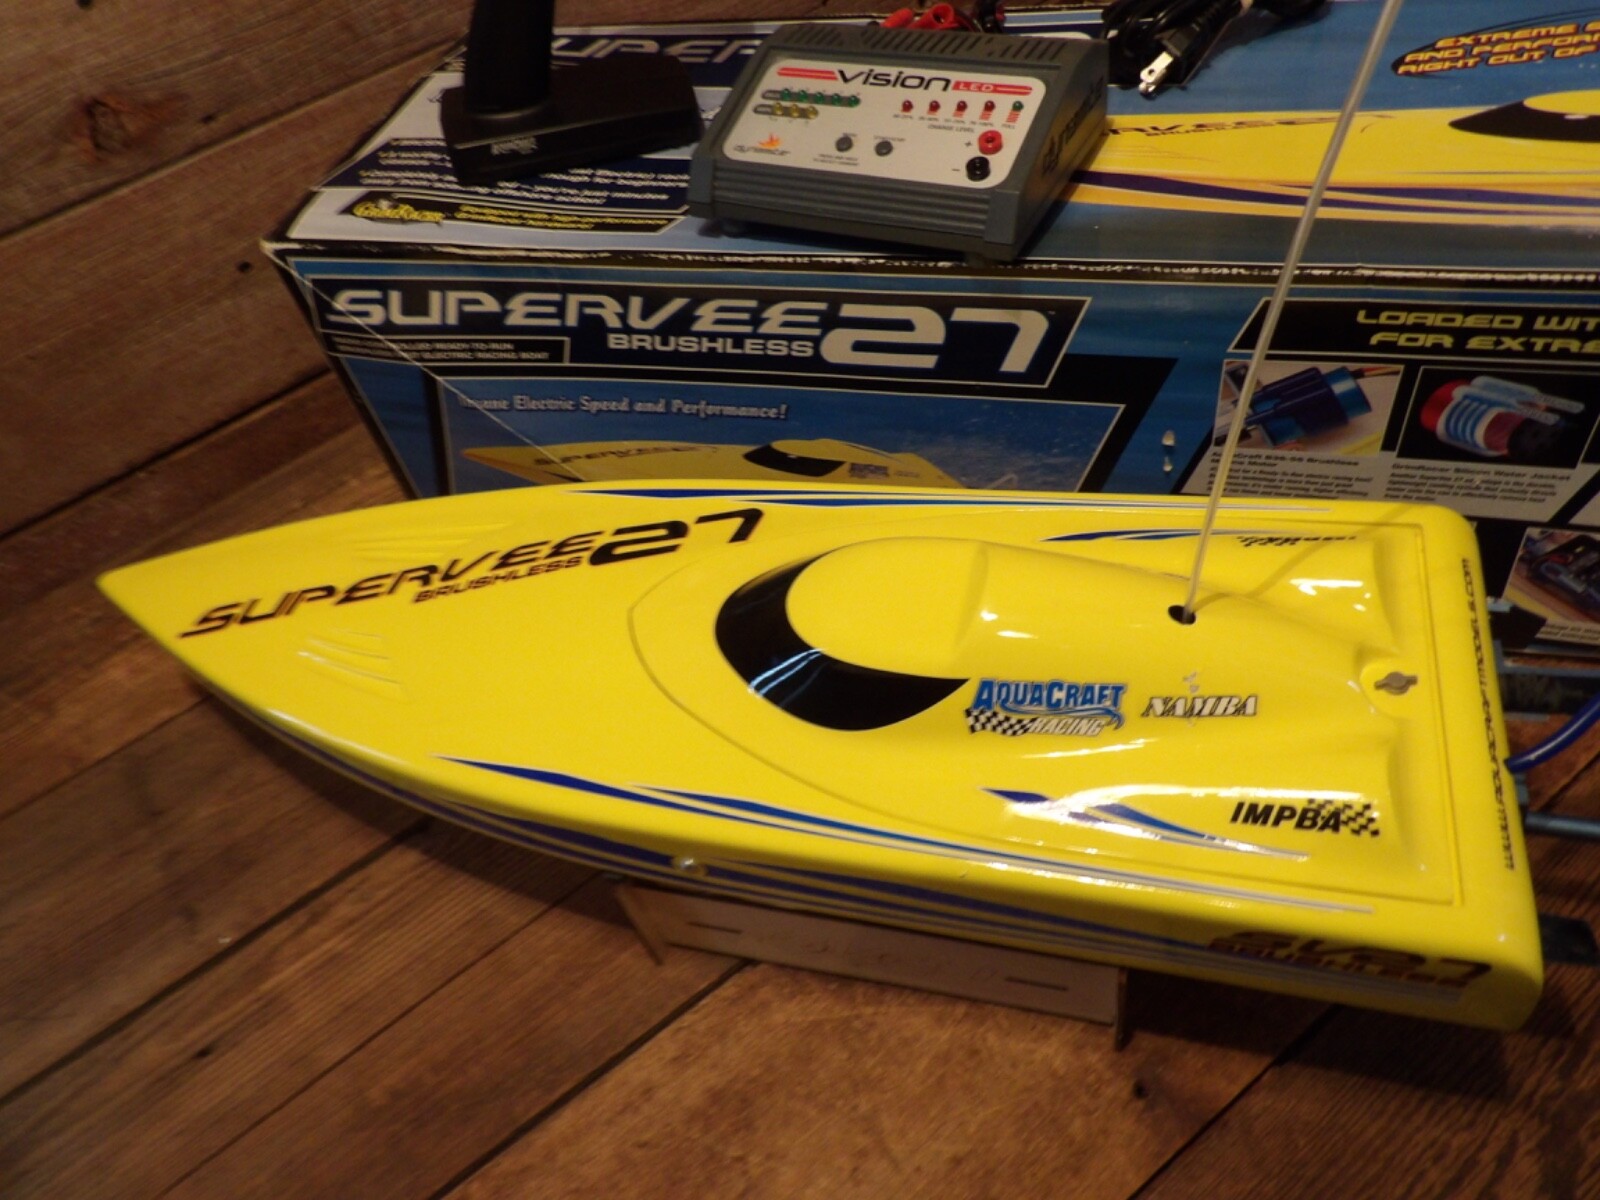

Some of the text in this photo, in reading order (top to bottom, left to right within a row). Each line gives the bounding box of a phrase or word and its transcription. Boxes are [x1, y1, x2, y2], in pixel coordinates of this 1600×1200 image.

[1434, 22, 1578, 49] EXTREME
[1396, 43, 1598, 75] RIGHT OUT OF
[1403, 47, 1464, 64] AND
[838, 68, 994, 93] vision LED
[325, 289, 1050, 373] SUPERVEE 27
[1355, 309, 1524, 330] LOADED
[607, 332, 815, 358] BRUSHLESS
[1369, 331, 1454, 349] FOR
[513, 395, 577, 411] Electric
[580, 396, 630, 414] Speed
[633, 397, 667, 413] and
[670, 399, 788, 420] Performance!
[177, 507, 765, 639] SUPERVEE 27
[413, 555, 584, 604] BRUSHLESS
[1140, 694, 1259, 718] NAMBA
[1027, 714, 1106, 738] RACING
[1229, 801, 1343, 835] IMPBA
